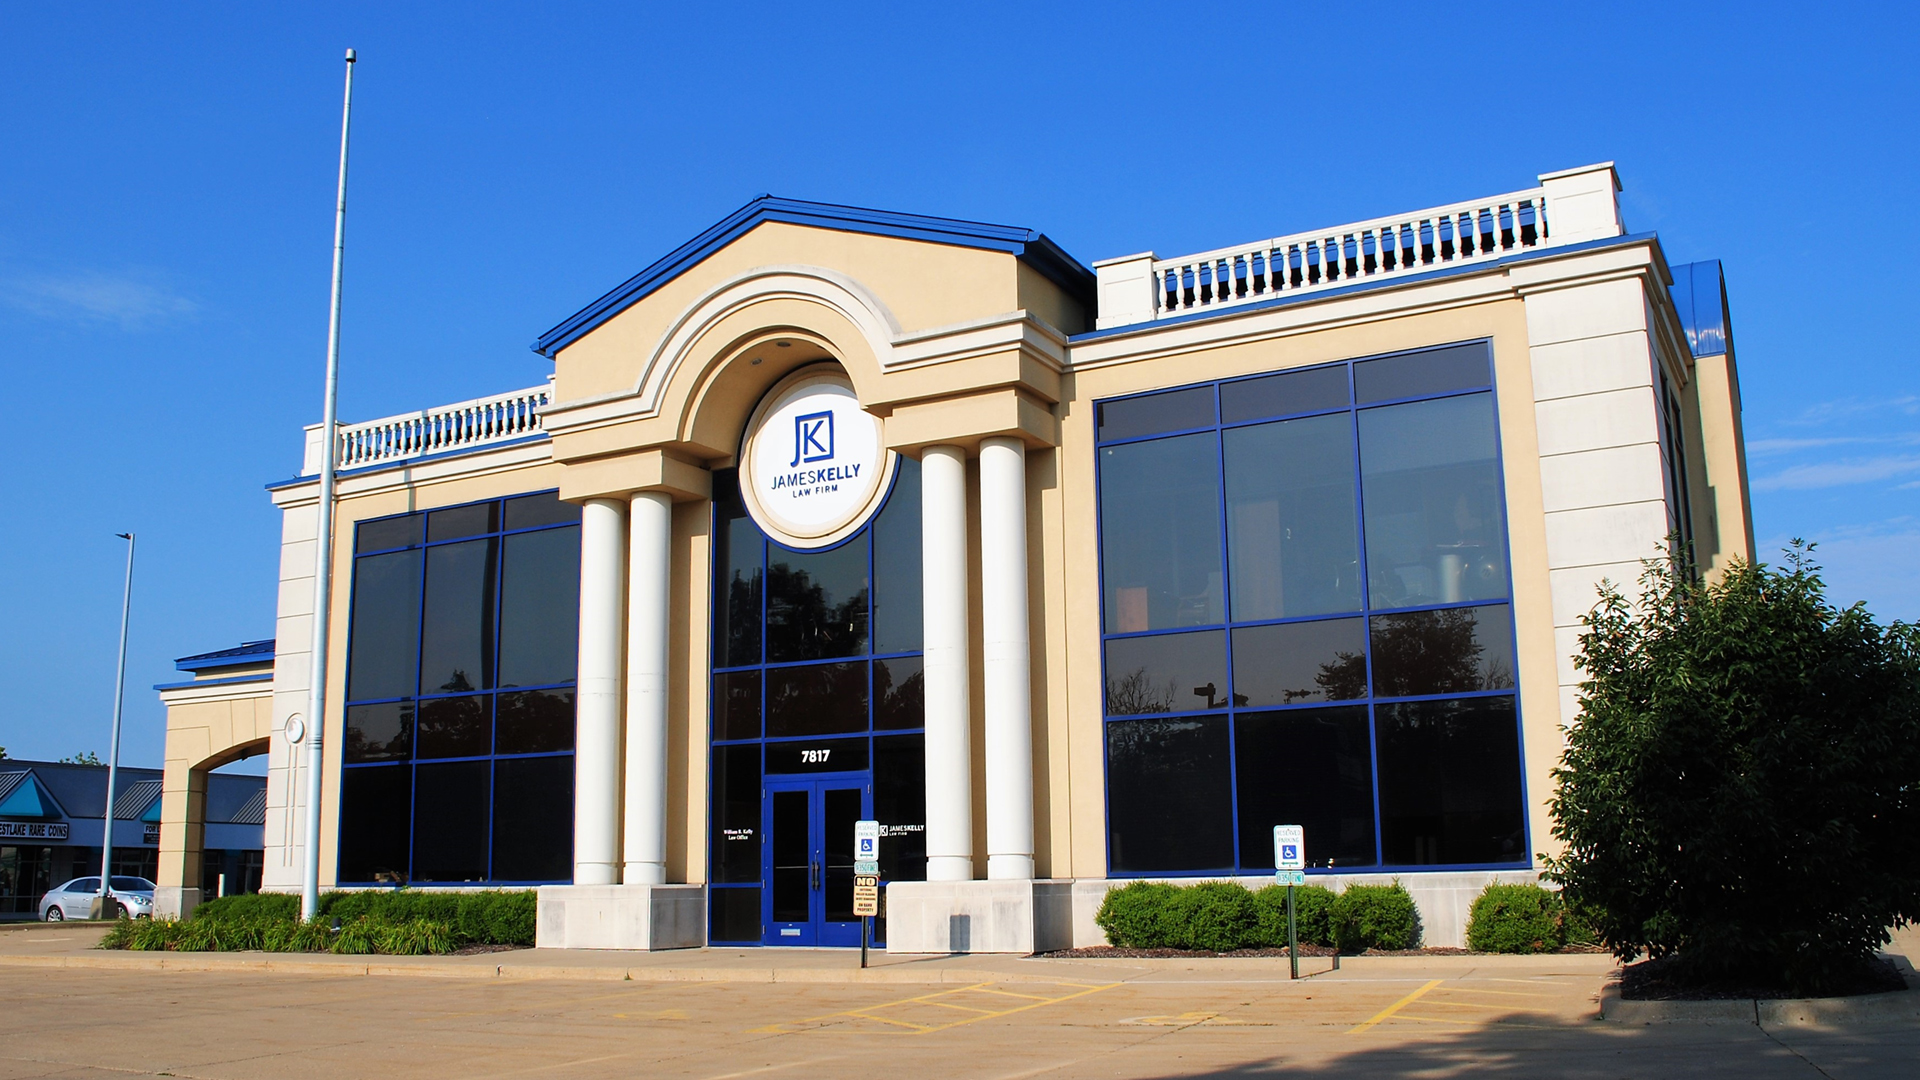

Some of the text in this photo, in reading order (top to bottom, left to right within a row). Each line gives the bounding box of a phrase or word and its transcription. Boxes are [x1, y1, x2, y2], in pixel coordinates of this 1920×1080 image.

[771, 463, 860, 490] JAMESKELLY
[793, 484, 838, 498] LAW FIRM
[801, 749, 831, 763] 7817
[29, 824, 45, 836] RARE
[48, 825, 67, 837] COINS
[145, 825, 156, 833] FOR
[856, 877, 875, 886] NO
